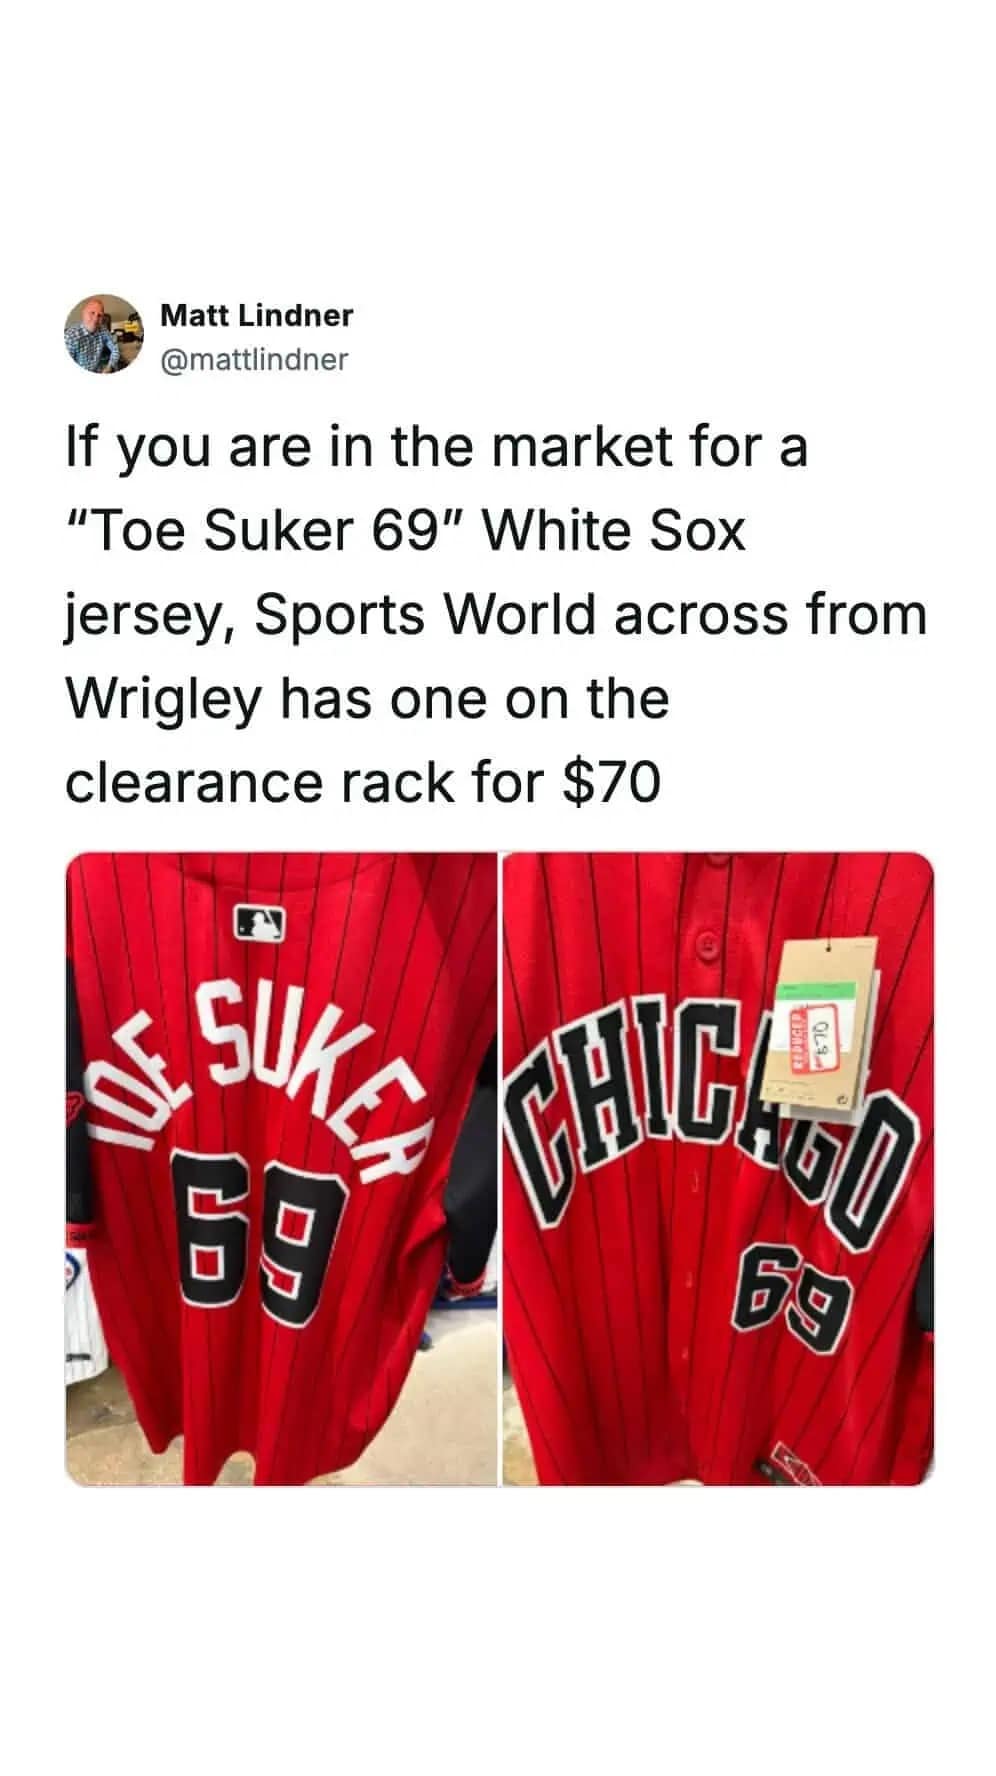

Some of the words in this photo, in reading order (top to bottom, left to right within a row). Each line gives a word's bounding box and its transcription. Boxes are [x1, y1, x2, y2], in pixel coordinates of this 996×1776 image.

[195, 978, 435, 1184] SUKER
[503, 993, 920, 1254] CHICAGO
[170, 1147, 350, 1328] 69
[731, 1242, 853, 1355] 69
